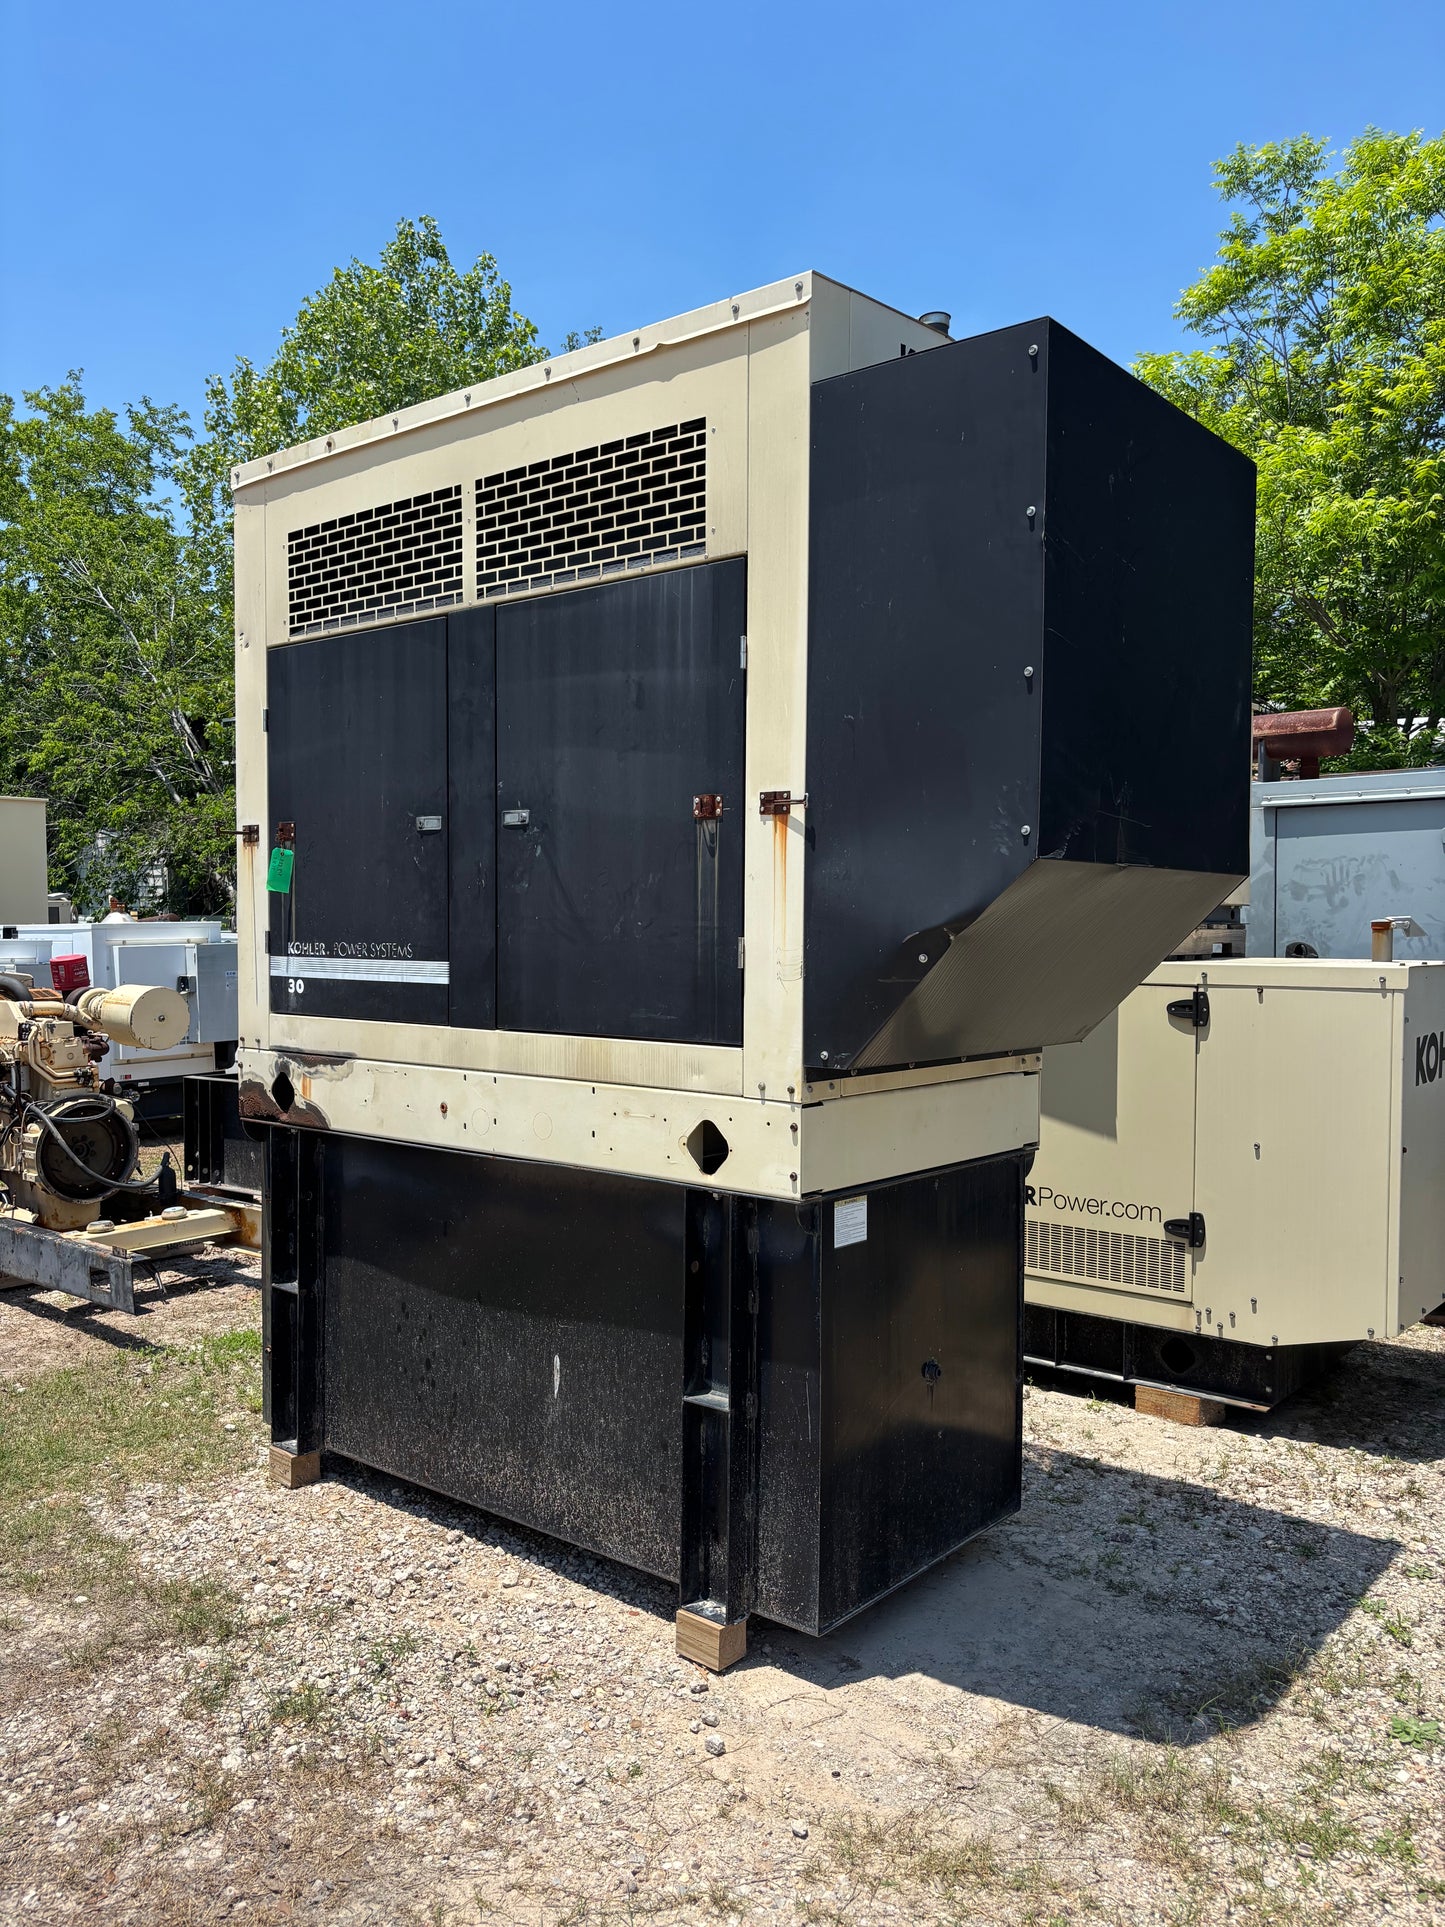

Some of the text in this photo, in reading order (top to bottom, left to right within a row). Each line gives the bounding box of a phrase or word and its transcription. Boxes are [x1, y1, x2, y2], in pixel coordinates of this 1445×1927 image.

[333, 941, 368, 957] POWER
[370, 942, 413, 958] SYSTEMS
[288, 978, 304, 993] 30
